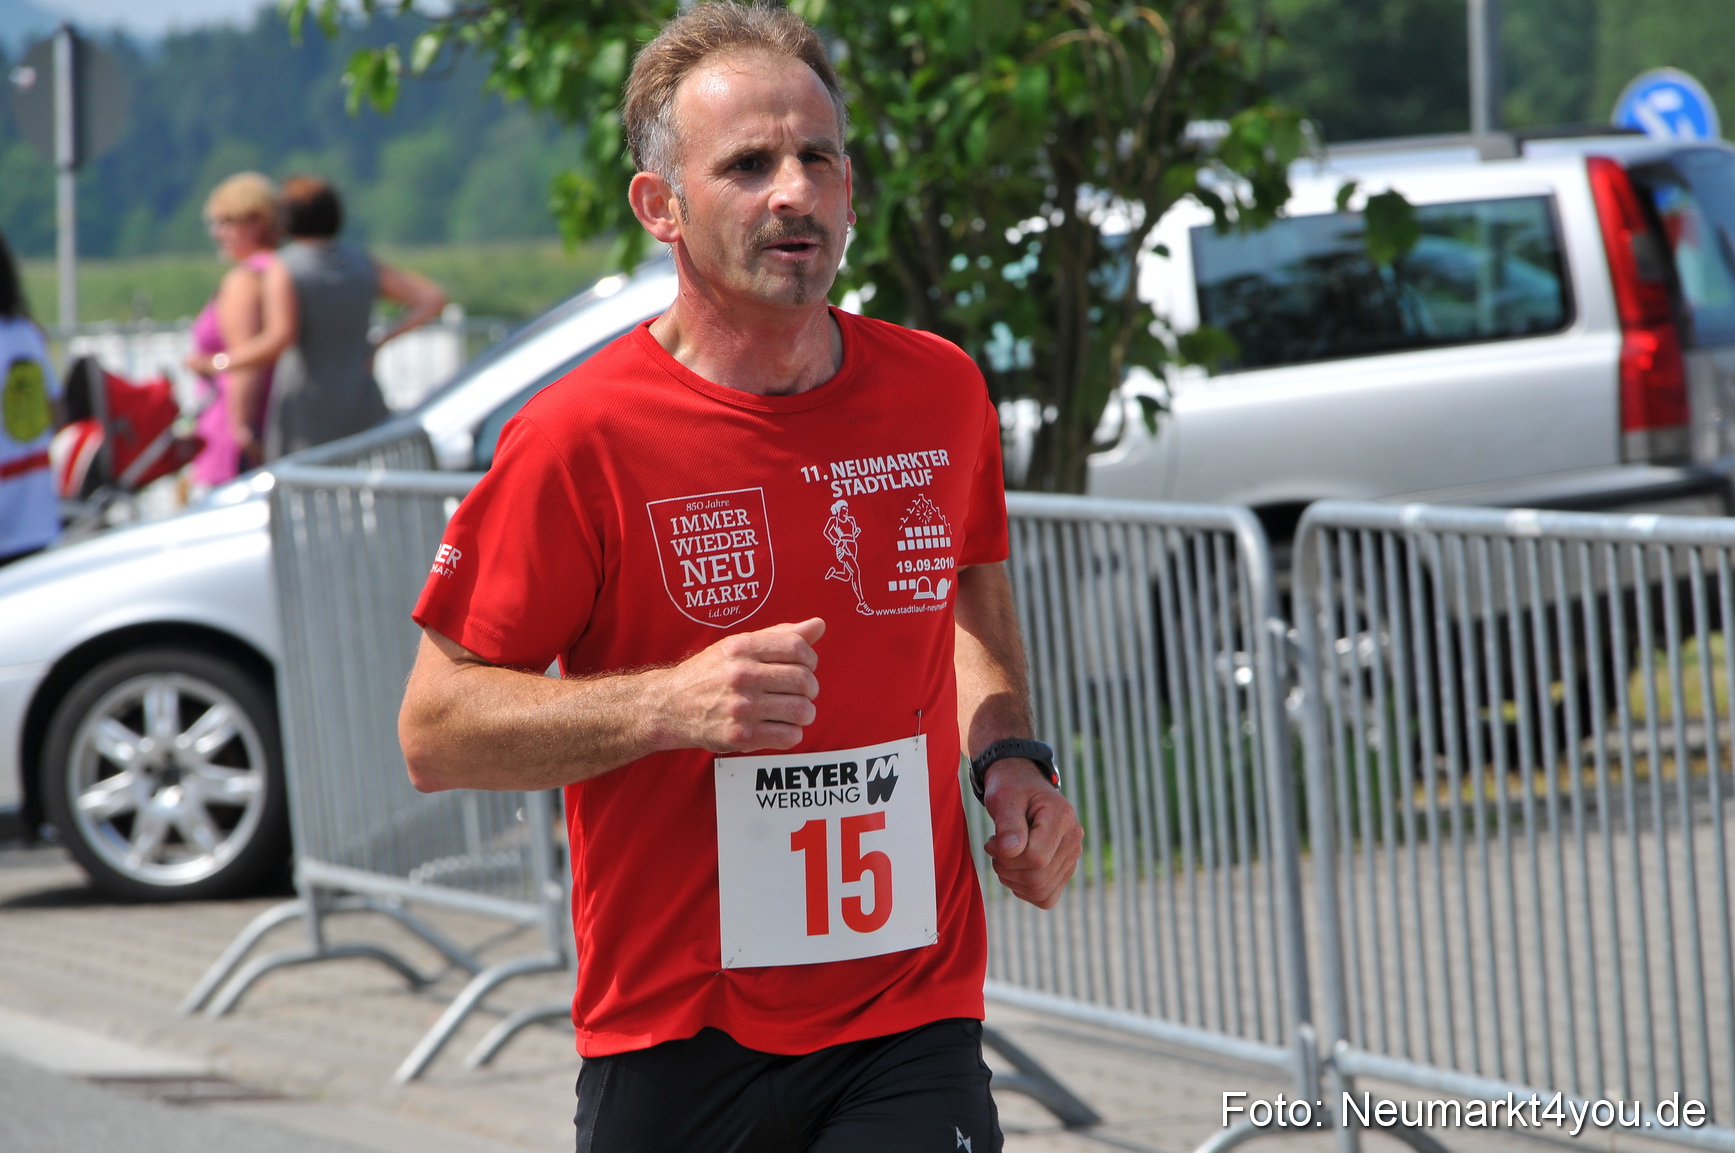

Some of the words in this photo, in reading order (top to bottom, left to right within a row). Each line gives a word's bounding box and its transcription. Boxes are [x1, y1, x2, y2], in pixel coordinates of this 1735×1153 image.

[830, 449, 950, 479] NEUMARKTER
[830, 469, 933, 498] STADTLAUF
[686, 501, 703, 512] 850
[705, 499, 730, 509] Jahre
[670, 509, 751, 535] IMMER
[670, 529, 759, 557] WIEDER
[680, 550, 755, 587] NEU
[896, 556, 955, 574] 19.09.2010
[685, 581, 759, 608] MARKT
[755, 761, 859, 791] MEYER
[756, 786, 861, 810] WERBUNG
[790, 810, 893, 937] 15
